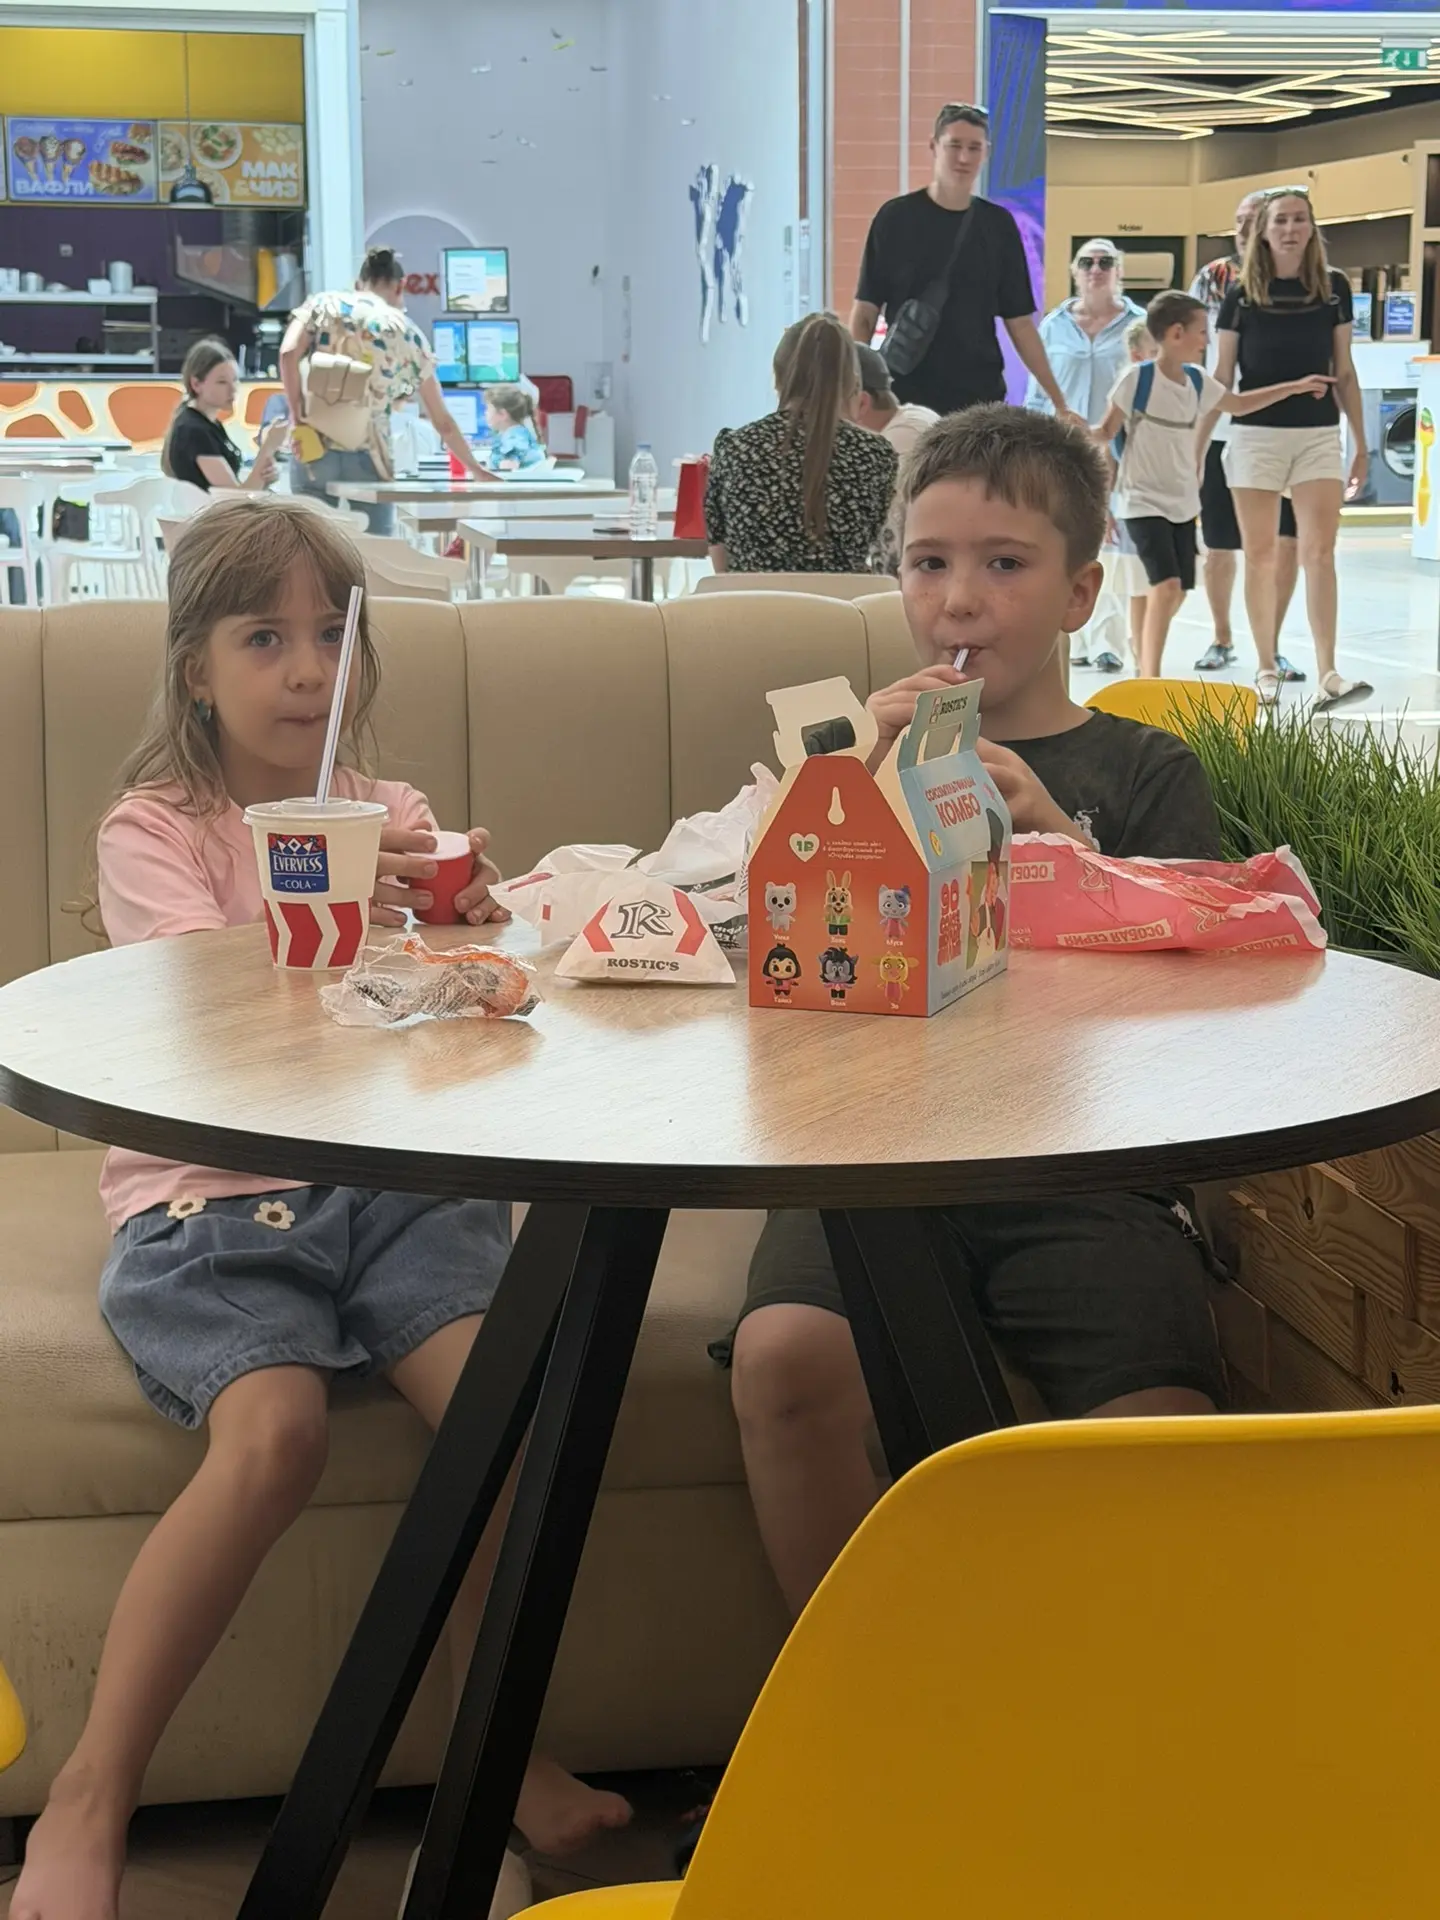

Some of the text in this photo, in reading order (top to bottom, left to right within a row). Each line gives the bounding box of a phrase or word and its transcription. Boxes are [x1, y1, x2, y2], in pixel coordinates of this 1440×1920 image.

[242, 160, 298, 178] МАК
[15, 179, 95, 195] ВАФЛИ
[249, 180, 298, 198] ЧИЗ
[935, 792, 981, 828] КОМБО
[273, 854, 323, 873] EVERVESS
[284, 879, 312, 889] COLA
[610, 900, 674, 939] R
[1063, 922, 1166, 946] ОСОБАЯ СЕРИЯ
[607, 958, 680, 971] ROSTIC'S
